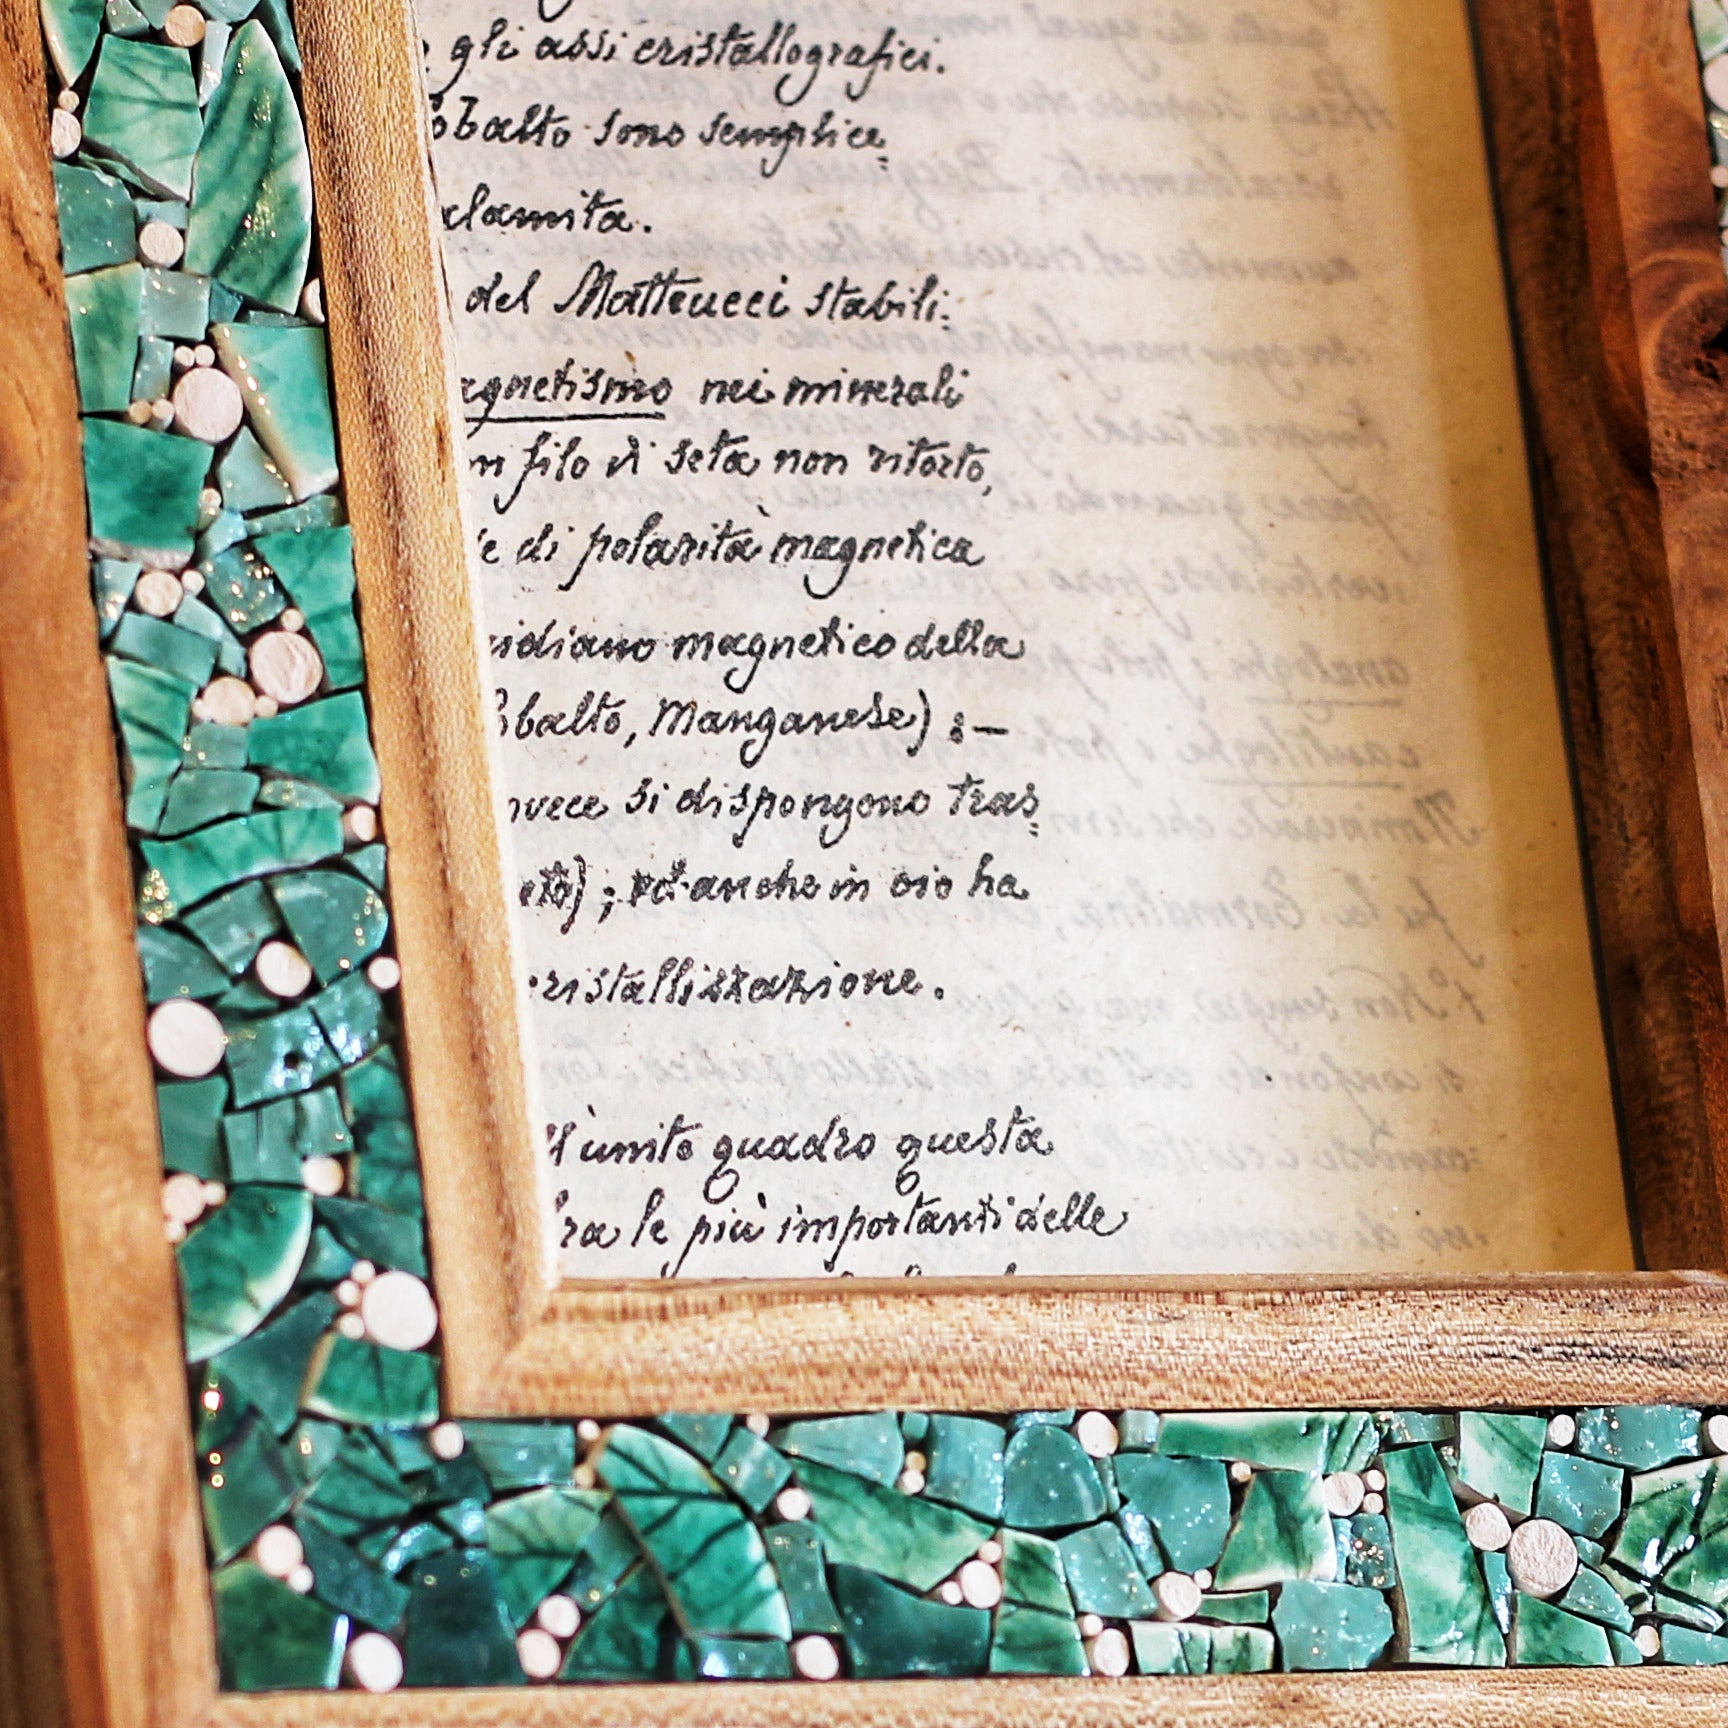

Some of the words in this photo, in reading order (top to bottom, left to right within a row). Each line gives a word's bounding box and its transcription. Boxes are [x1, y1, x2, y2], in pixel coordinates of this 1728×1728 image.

[433, 17, 522, 97] gli
[535, 29, 628, 62] assi
[593, 108, 685, 148] sono
[465, 269, 541, 315] del
[700, 368, 776, 405] nei
[783, 363, 969, 409] minerali
[493, 430, 590, 515] filo
[605, 435, 656, 479] di
[664, 428, 761, 477] seta
[774, 449, 848, 475] non
[516, 523, 575, 564] di
[769, 520, 985, 600] magnetica
[672, 615, 896, 695] magnetico
[904, 618, 1024, 661] della
[675, 777, 931, 850] dispongono
[829, 864, 870, 902] in
[968, 852, 1029, 900] ha
[702, 1113, 876, 1205] quadro
[894, 1104, 1054, 1196] questa
[630, 1187, 668, 1247] le
[671, 1192, 767, 1278] più
[776, 1191, 1017, 1272] importanti
[1015, 1191, 1128, 1237] delle
